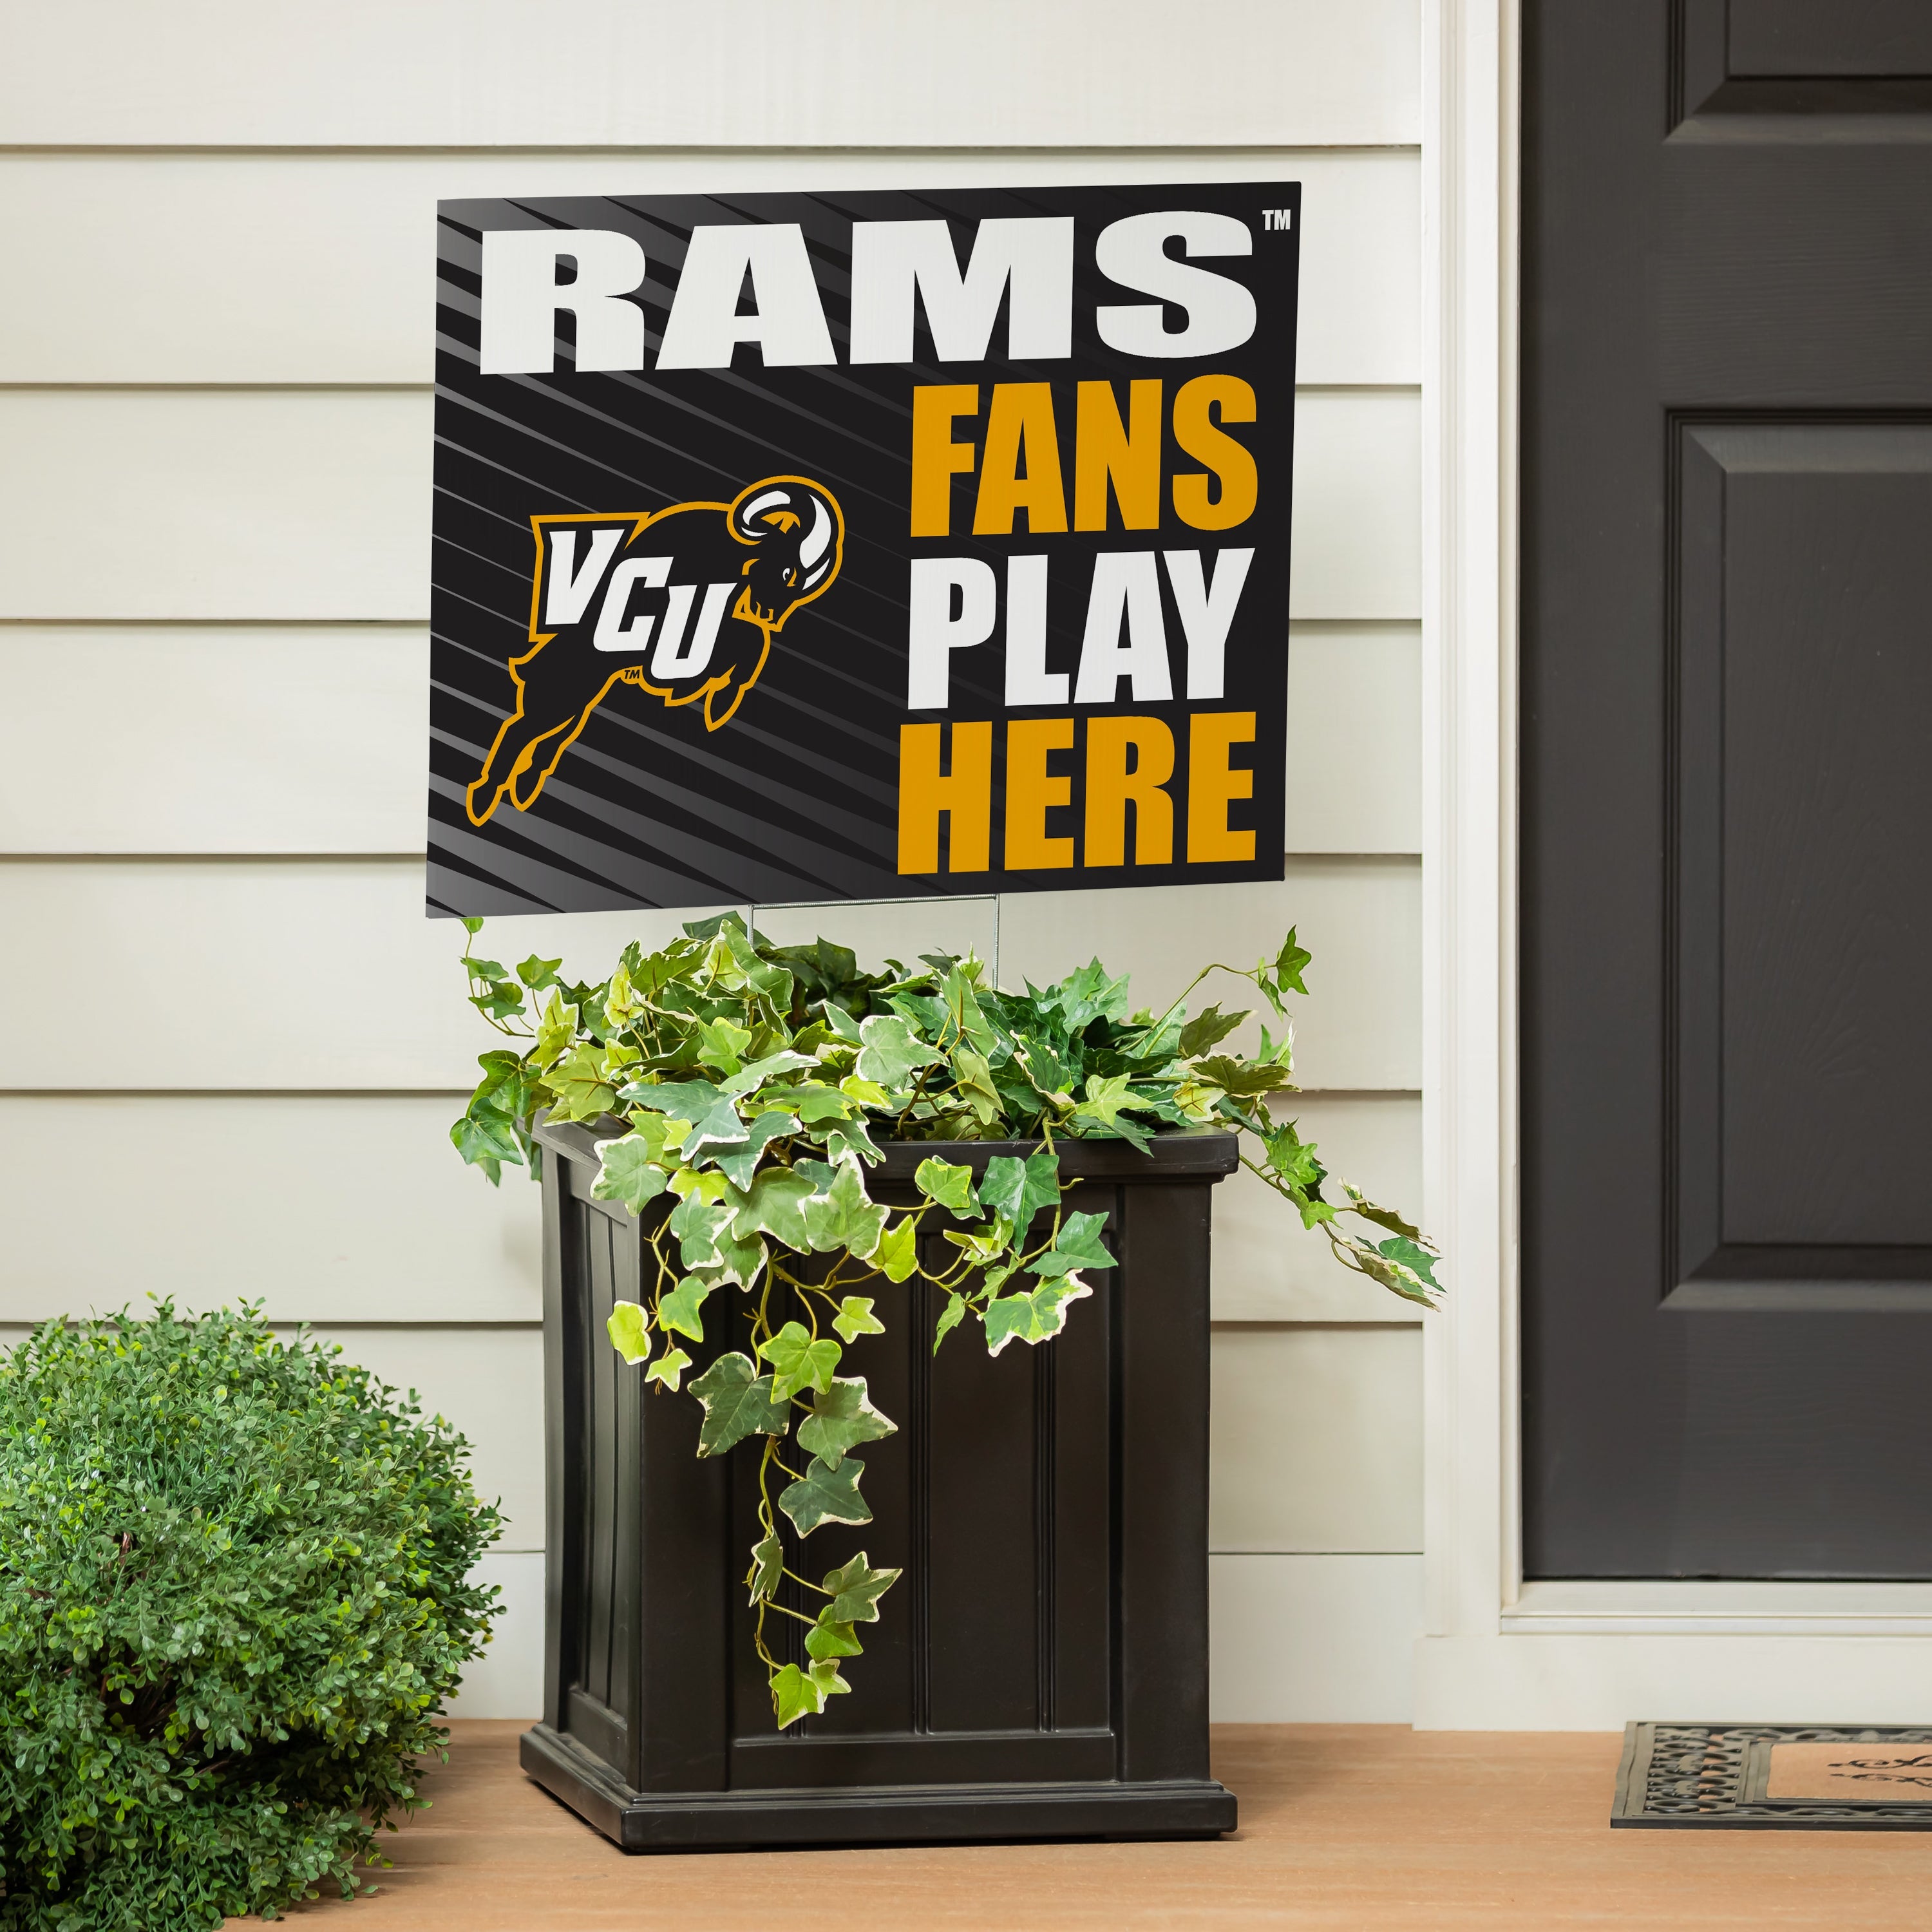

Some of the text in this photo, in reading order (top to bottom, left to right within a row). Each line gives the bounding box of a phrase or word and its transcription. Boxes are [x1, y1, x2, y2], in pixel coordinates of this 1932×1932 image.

[480, 209, 1291, 375] RAMS TM
[910, 374, 1258, 538] FANS
[545, 529, 738, 679] VCU
[624, 669, 640, 679] TM
[907, 547, 1256, 710] PLAY
[897, 711, 1256, 875] HERE
